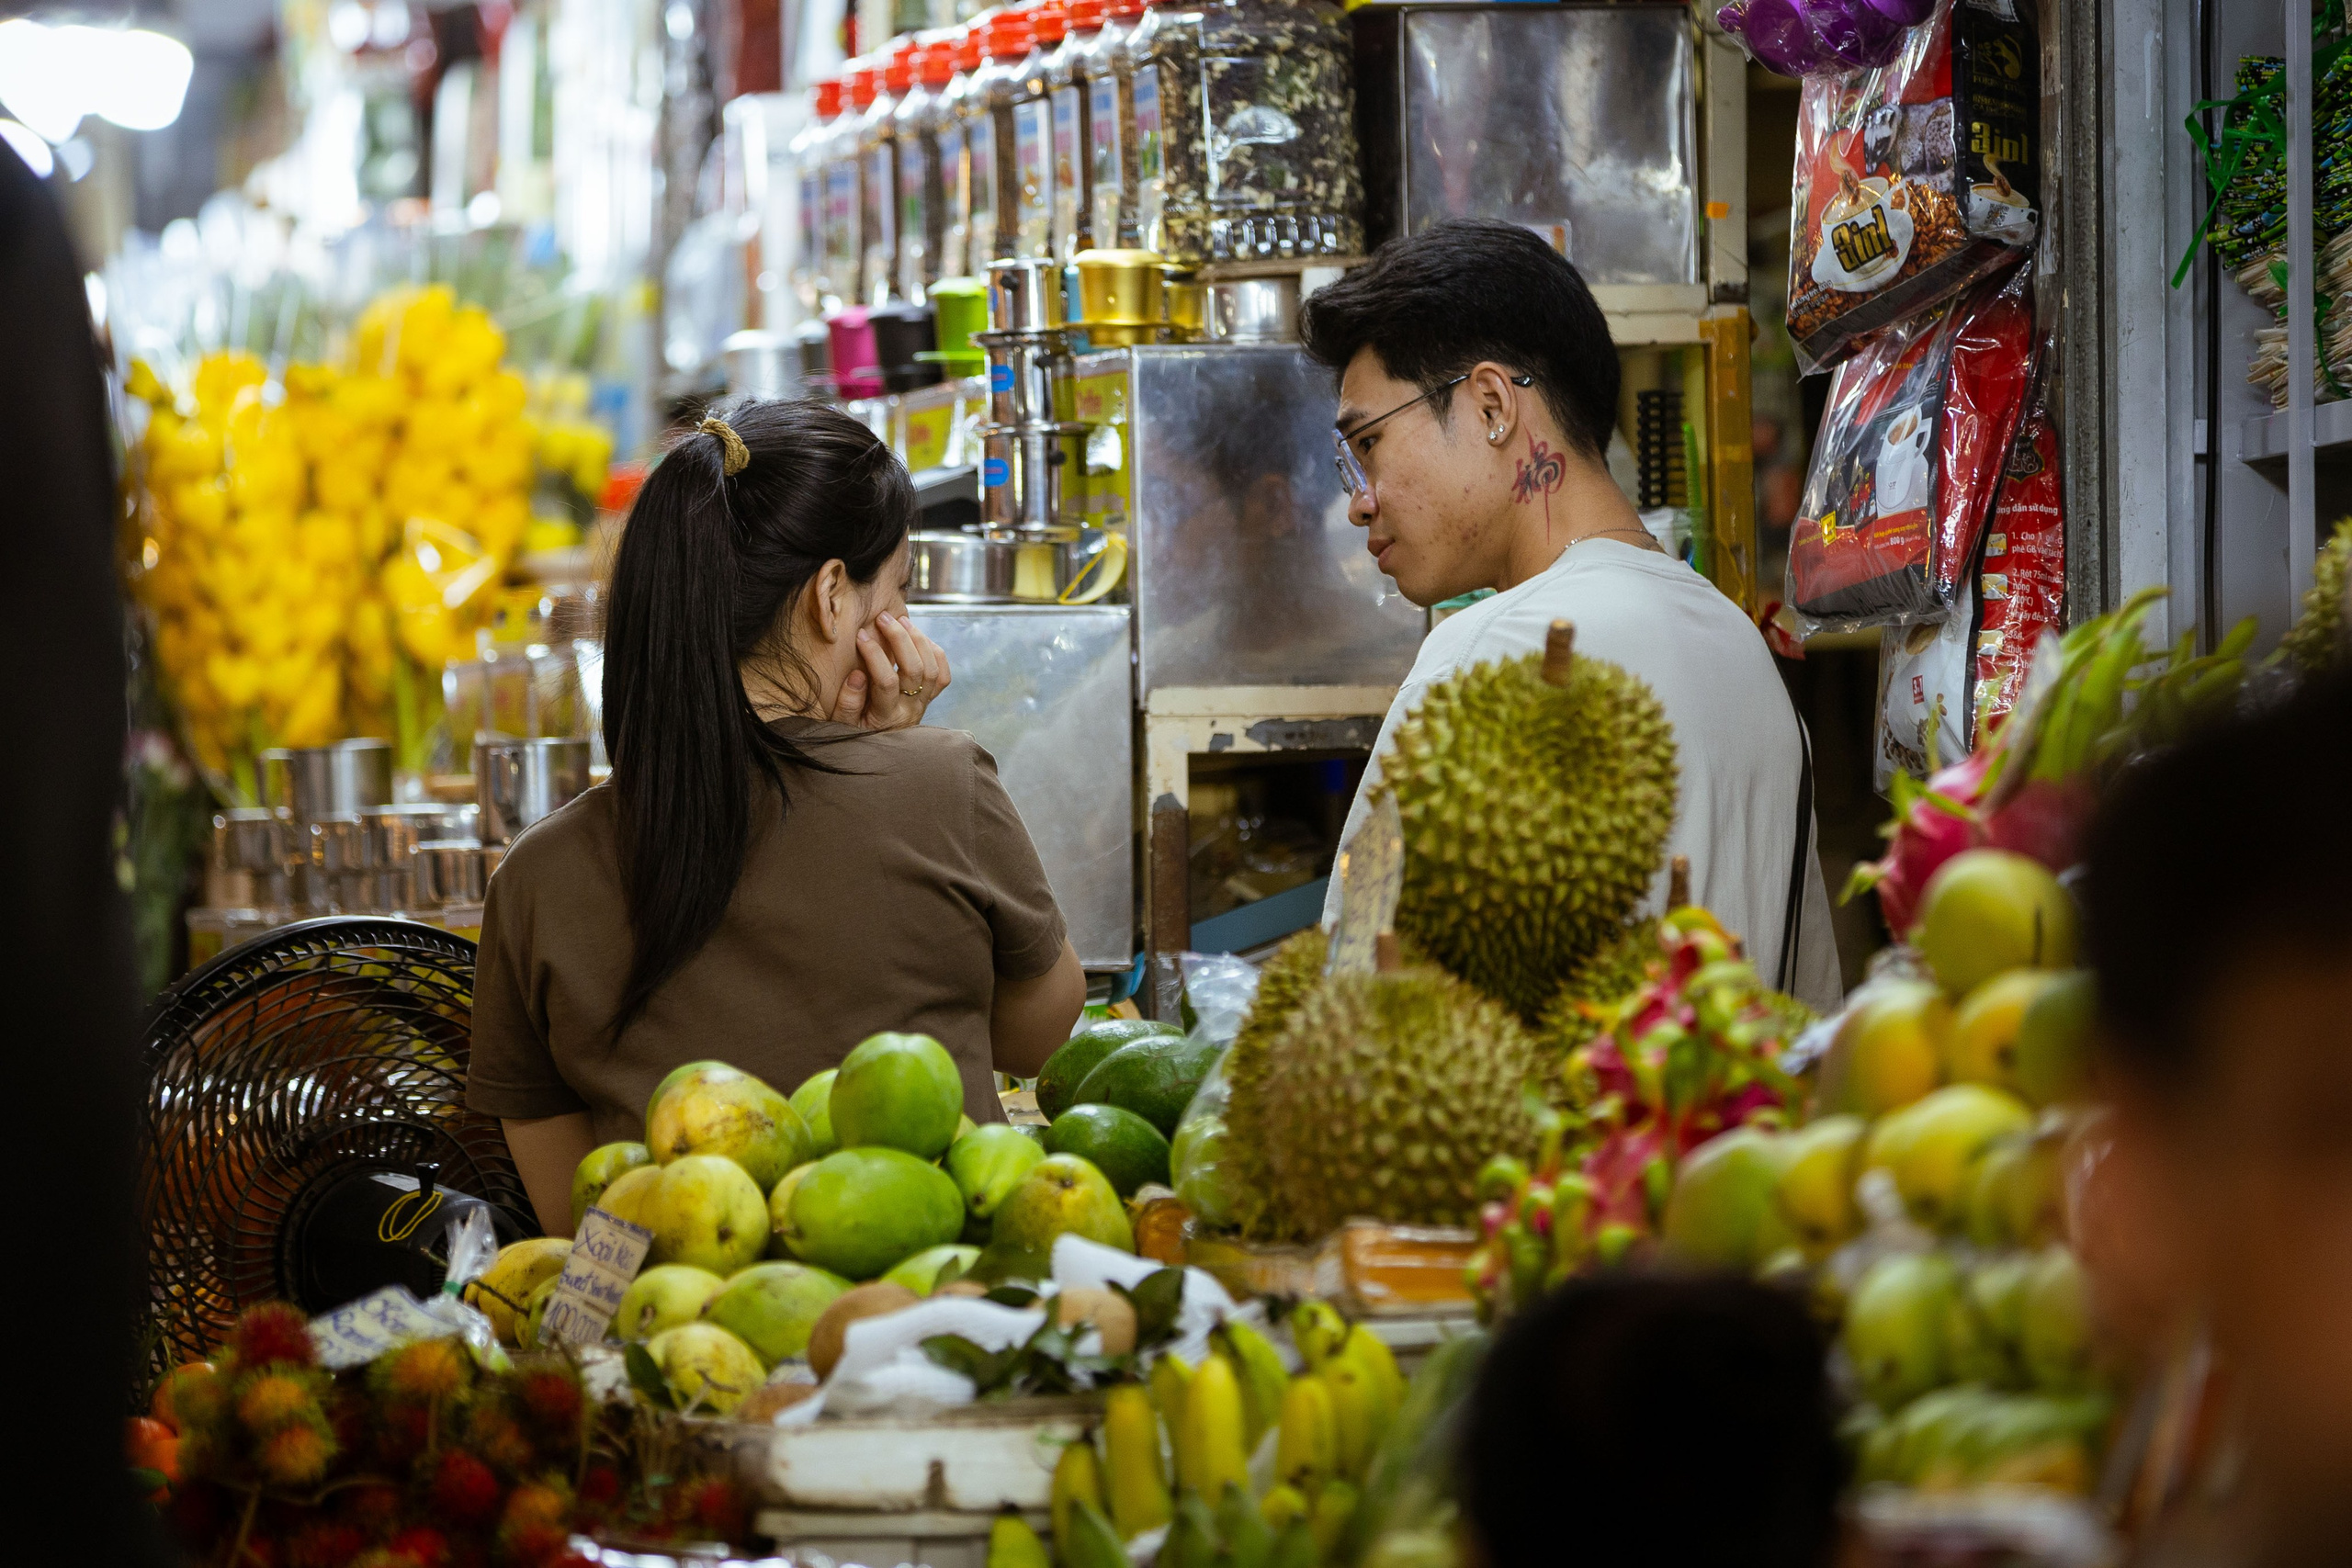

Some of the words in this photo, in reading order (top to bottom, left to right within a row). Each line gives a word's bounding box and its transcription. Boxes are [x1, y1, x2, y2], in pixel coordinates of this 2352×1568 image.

[1972, 121, 2029, 164] 3in1
[1832, 204, 1894, 274] 3in1
[2040, 503, 2058, 516] dụng
[1890, 536, 1901, 546] 800
[1900, 536, 1905, 546] g
[2021, 531, 2035, 540] Cho
[2012, 568, 2019, 577] 2.
